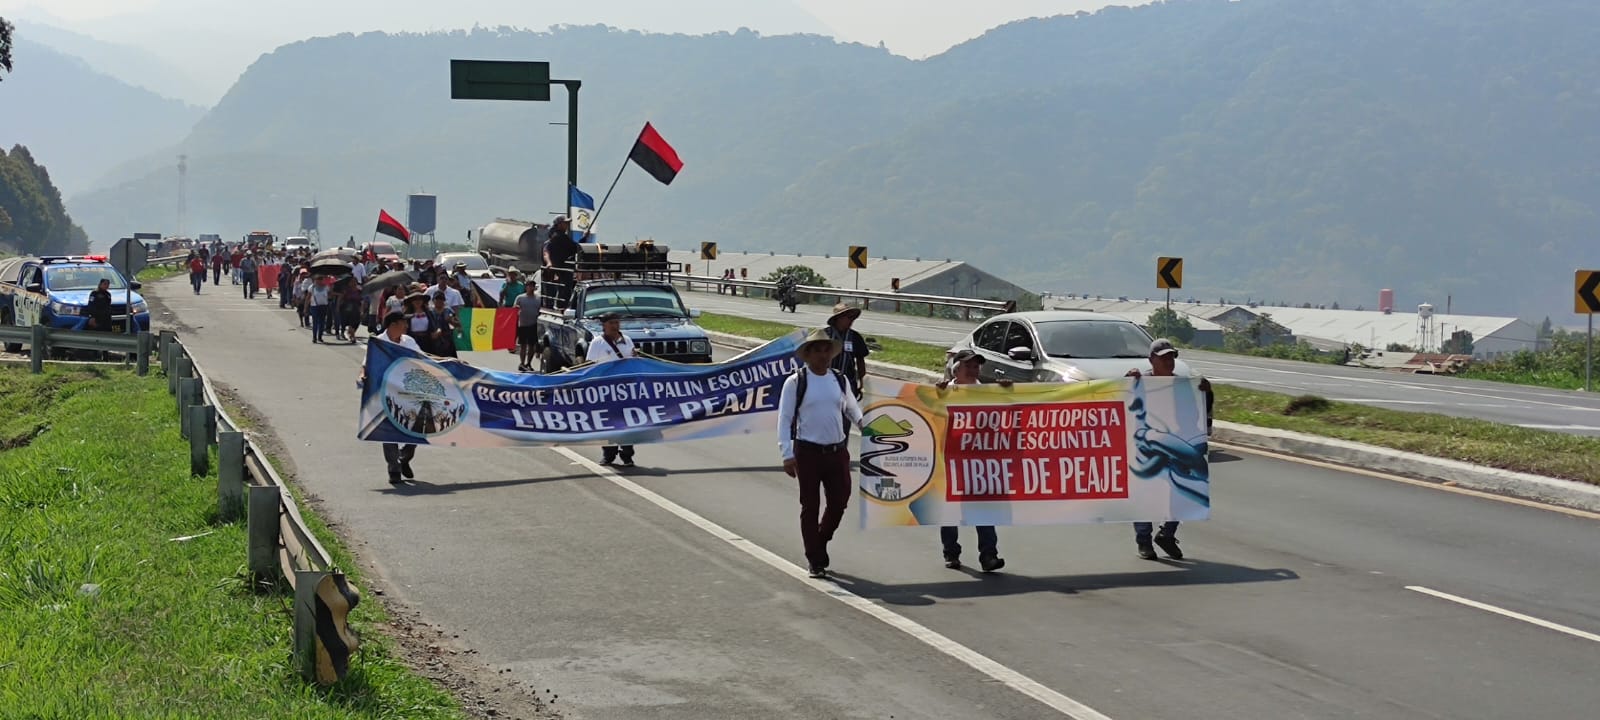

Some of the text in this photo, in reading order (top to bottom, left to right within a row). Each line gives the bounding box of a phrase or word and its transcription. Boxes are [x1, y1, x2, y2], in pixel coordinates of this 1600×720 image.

[477, 386, 548, 407] BLOQUE
[553, 382, 650, 406] AUTOPISTA
[707, 357, 799, 392] ESCUINTLA
[512, 384, 774, 432] LIBRE DE PEAJE
[952, 408, 1121, 432] BLOQUE AUTOPISTA
[1016, 430, 1112, 450] ESCUINTLA
[950, 455, 1123, 496] LIBRE DE PEAJE
